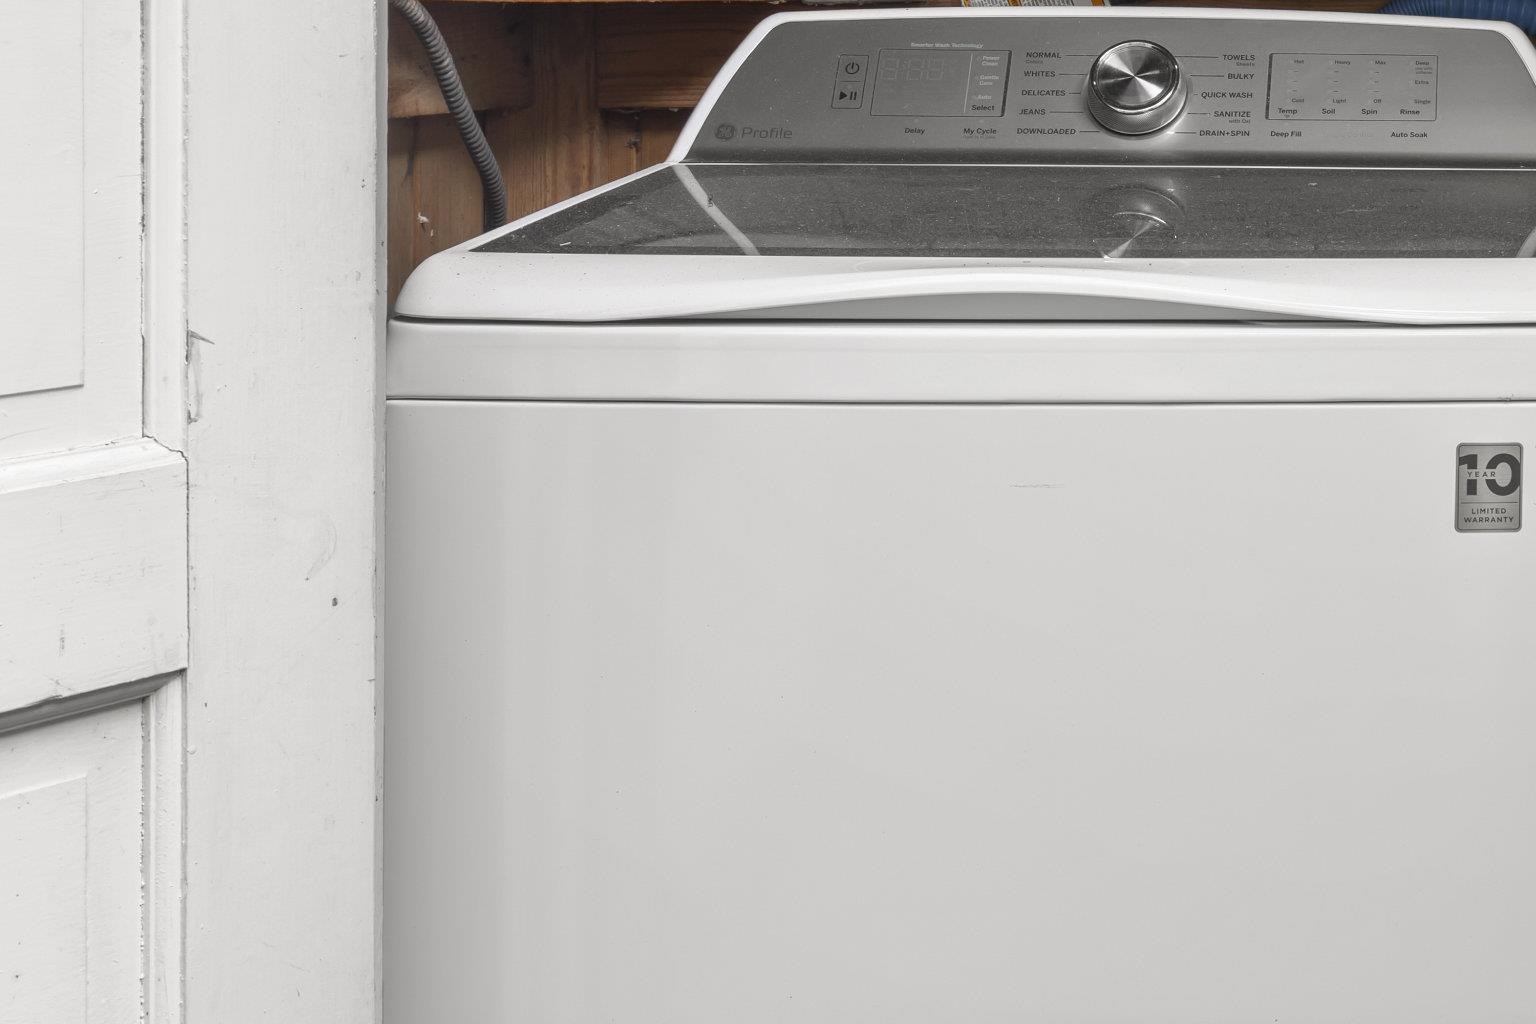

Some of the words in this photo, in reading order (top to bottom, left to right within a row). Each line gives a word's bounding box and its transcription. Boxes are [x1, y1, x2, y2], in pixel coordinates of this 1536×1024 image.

[1025, 51, 1062, 59] NORMAL
[1222, 53, 1256, 61] TOWELS
[1023, 70, 1056, 78] WHITES
[1227, 72, 1255, 80] BULKY
[1021, 89, 1067, 97] DELICATES
[1200, 91, 1228, 99] QUICK
[1229, 91, 1253, 99] WASH
[971, 103, 995, 112] Select
[1277, 107, 1298, 116] Temp
[1018, 108, 1046, 116] JEANS
[1213, 110, 1252, 118] SANITIZE
[1361, 108, 1378, 116] Spin
[741, 126, 793, 139] Profile
[904, 127, 926, 136] Delay
[962, 127, 975, 136] My
[976, 127, 998, 136] Cycle
[1016, 127, 1077, 135] DOWNLOADED
[1199, 129, 1251, 137] DRAIN+SPIN
[1270, 130, 1289, 139] Deep
[1458, 452, 1520, 497] 10
[1471, 507, 1507, 515] LIMITED
